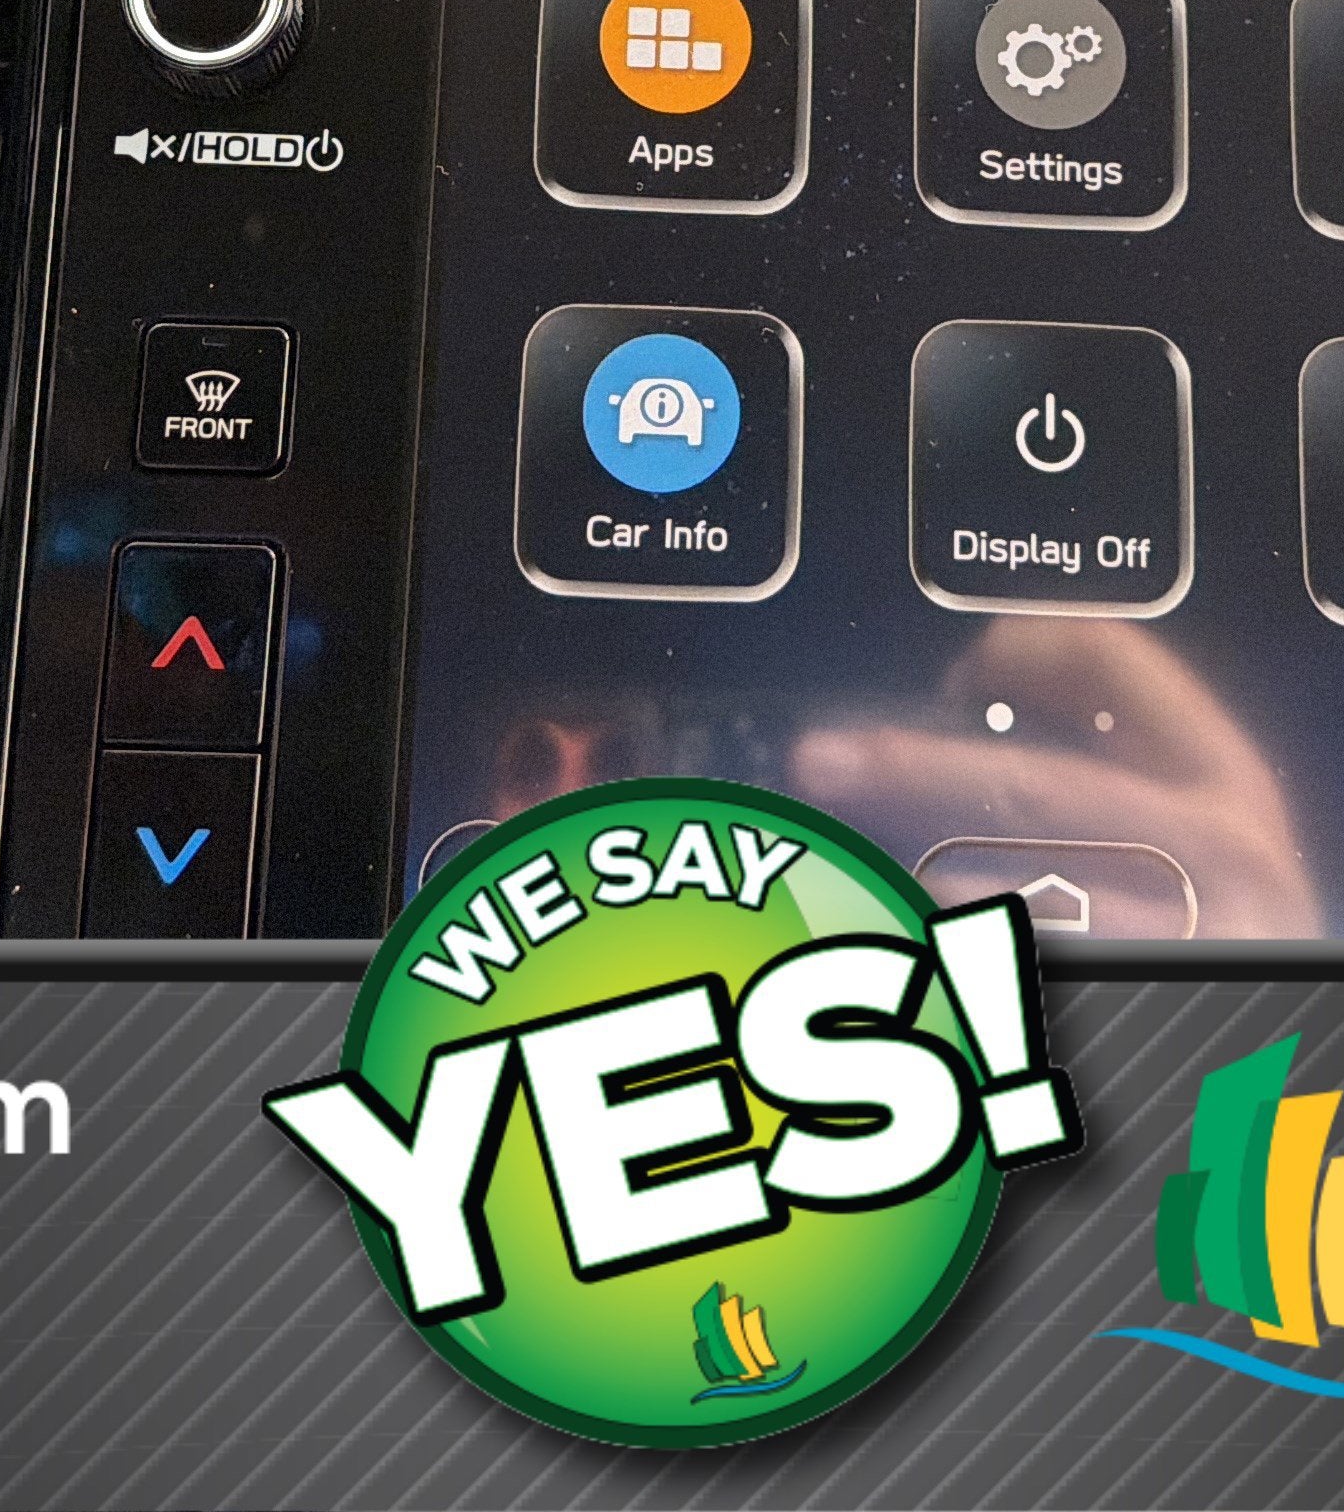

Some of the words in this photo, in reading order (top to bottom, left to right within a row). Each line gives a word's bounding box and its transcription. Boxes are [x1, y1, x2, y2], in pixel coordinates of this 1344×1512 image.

[628, 135, 715, 173] Apps
[978, 148, 1124, 191] Settings
[164, 416, 253, 441] FRONT
[585, 514, 651, 551] Car
[663, 518, 730, 553] Info
[952, 529, 1083, 573] Display
[1095, 536, 1152, 570] Off
